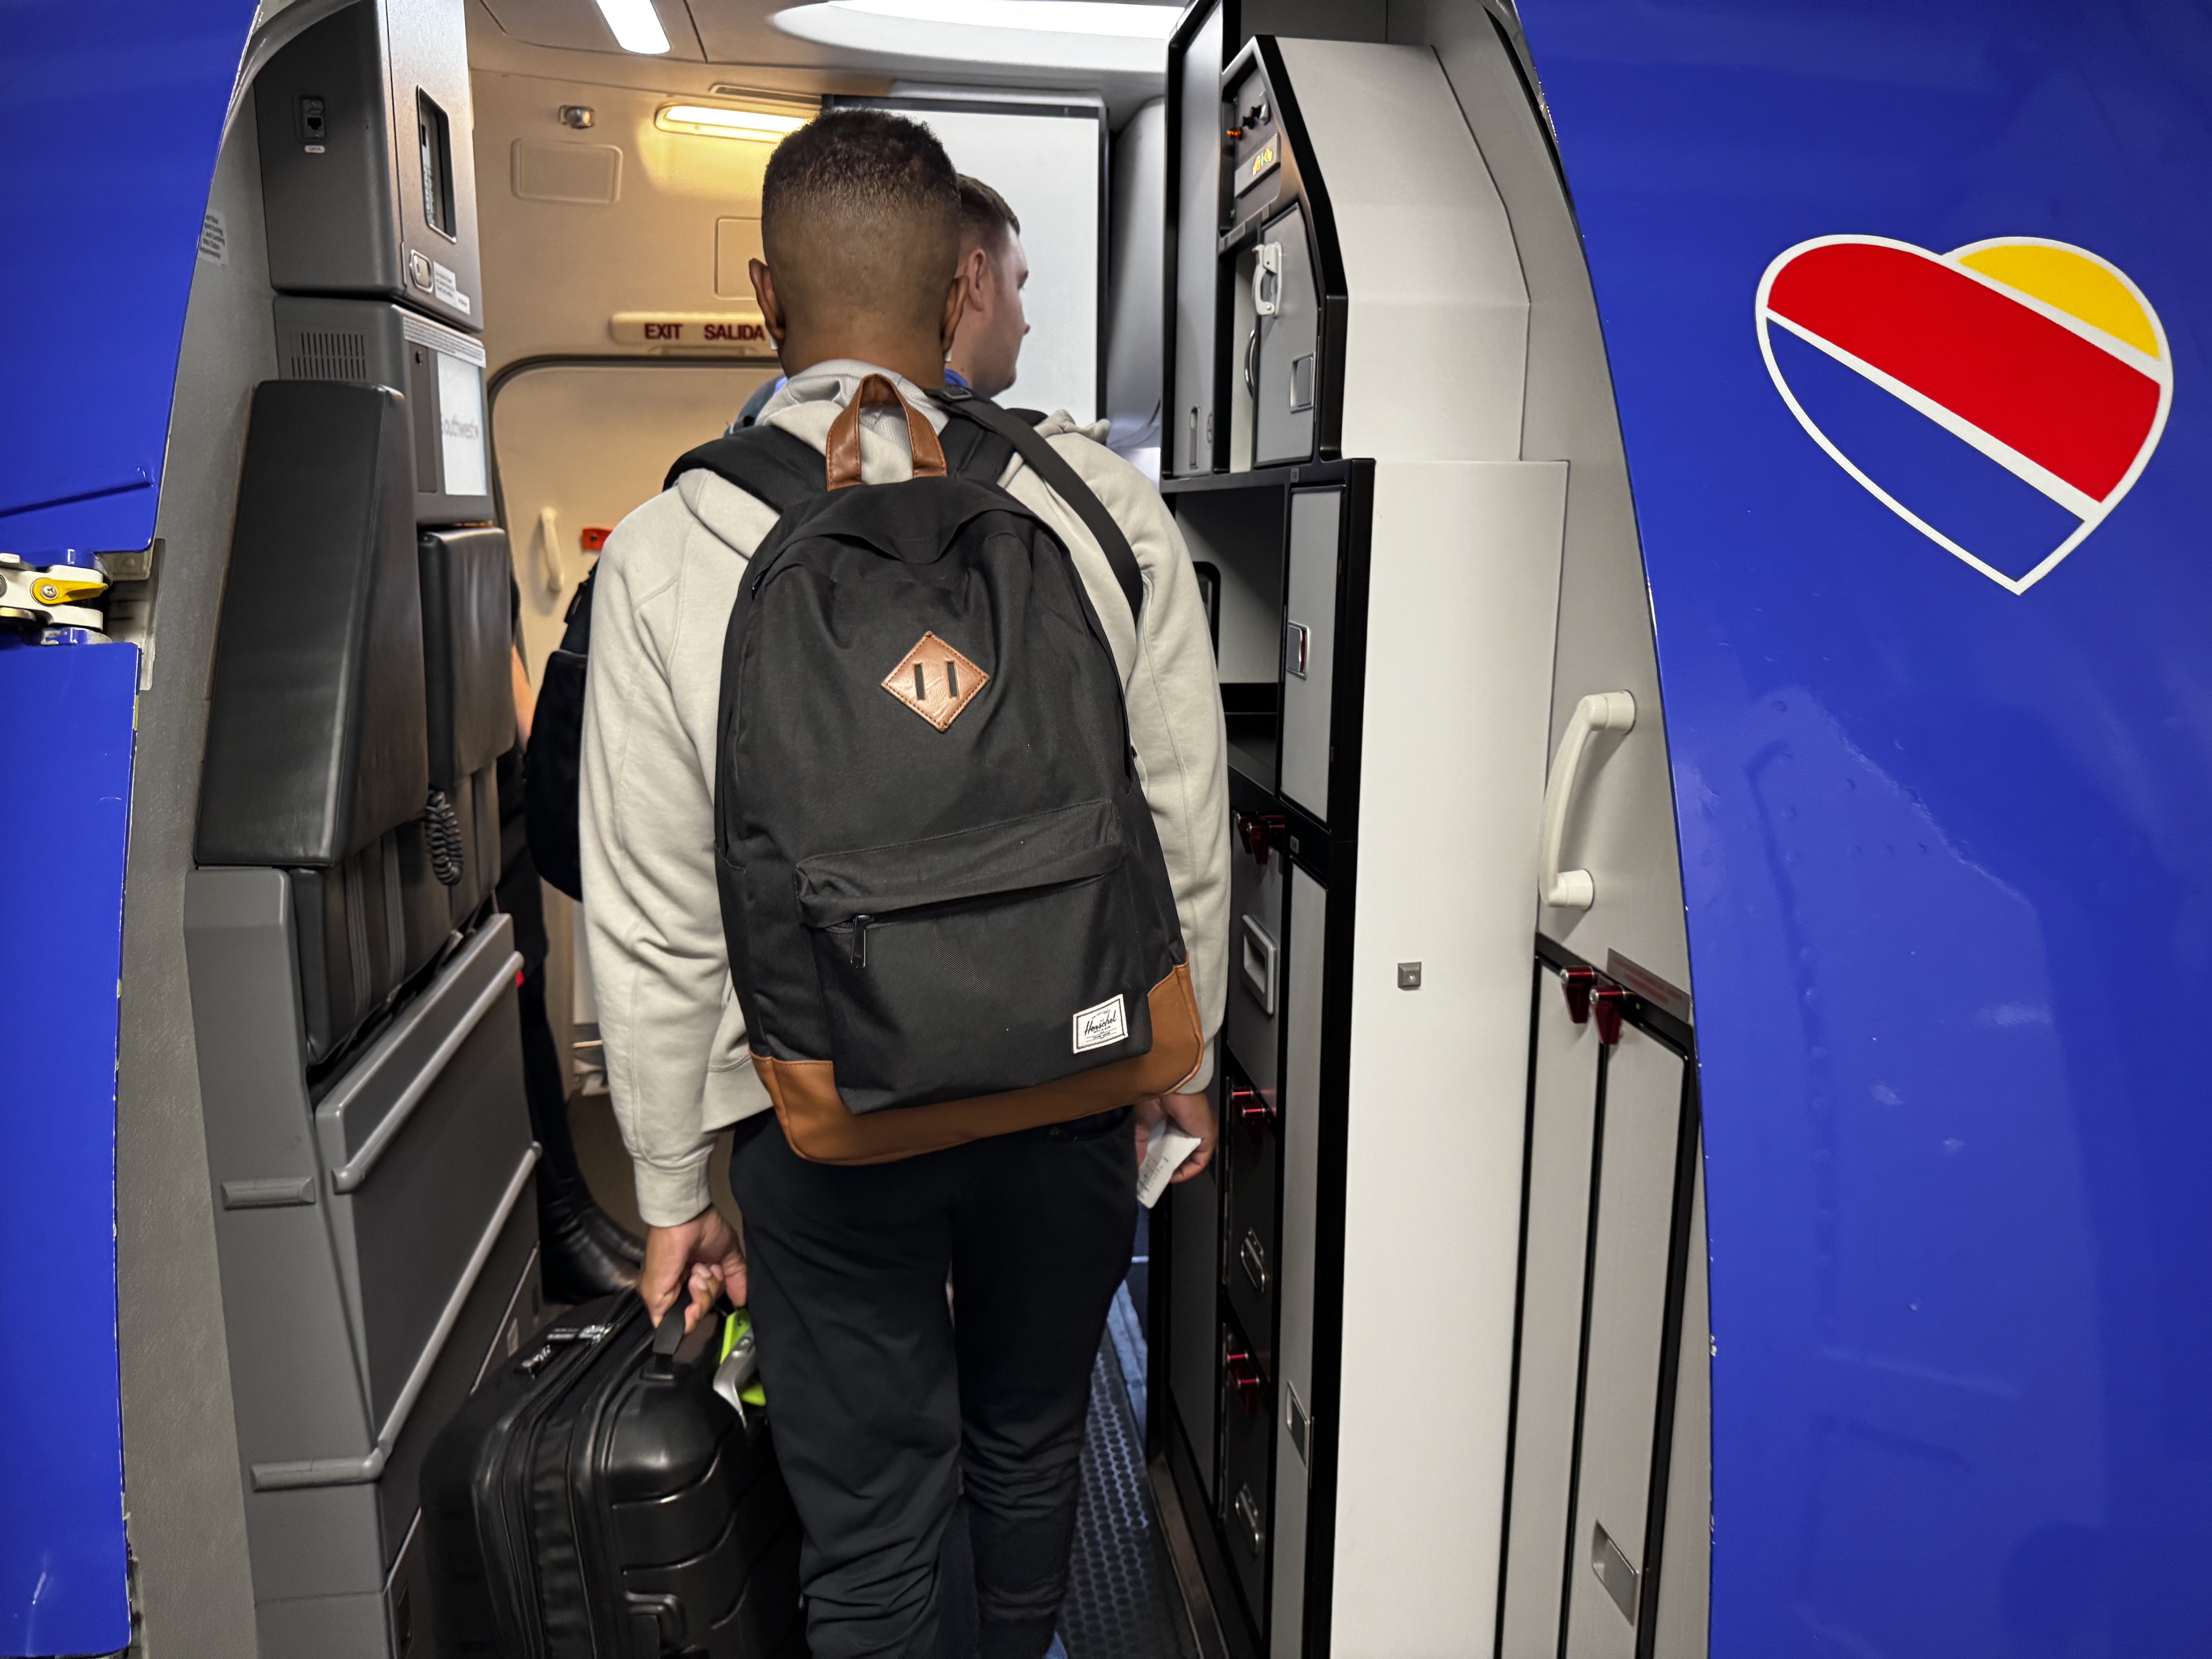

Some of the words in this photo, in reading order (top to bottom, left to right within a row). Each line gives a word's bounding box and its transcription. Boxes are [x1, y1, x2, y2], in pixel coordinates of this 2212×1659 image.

[644, 324, 683, 340] EXIT
[704, 324, 765, 341] SALIDA
[1084, 1009, 1117, 1036] Herschel
